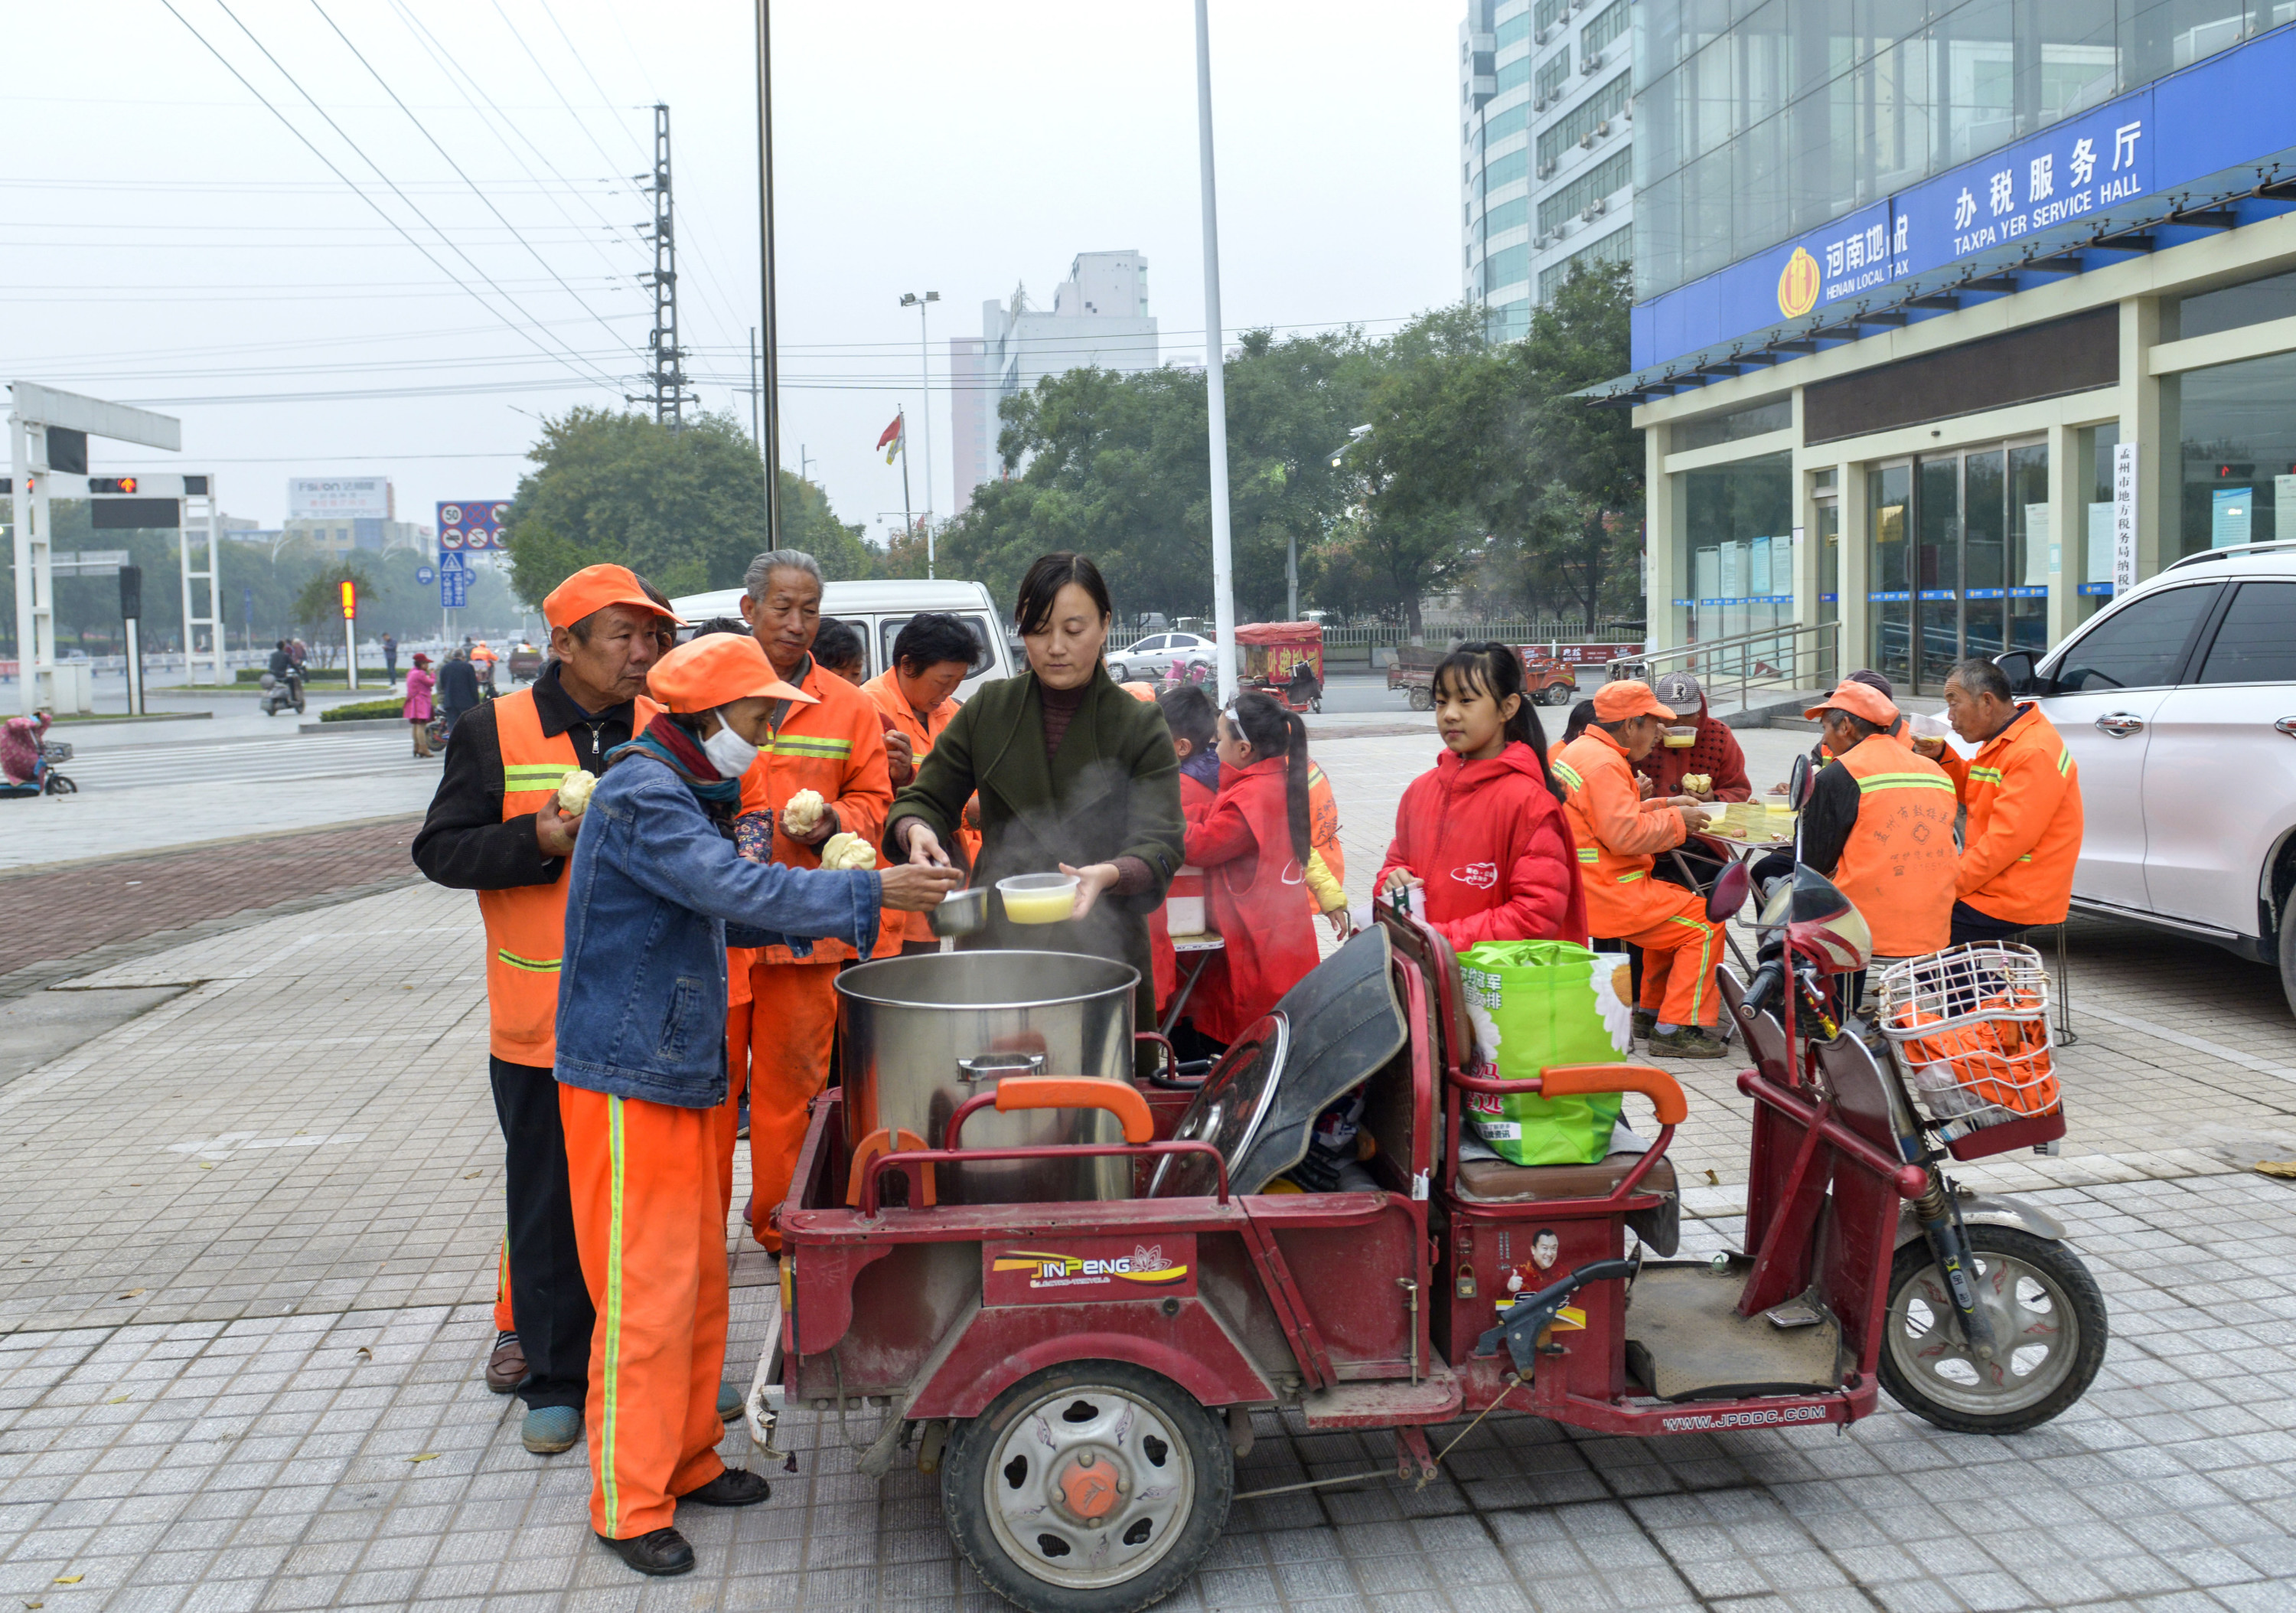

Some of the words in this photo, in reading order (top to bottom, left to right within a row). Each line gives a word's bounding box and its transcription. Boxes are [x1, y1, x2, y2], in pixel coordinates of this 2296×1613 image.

[1954, 120, 2142, 231] 办税服务厅
[1954, 225, 1996, 256] TAXPA
[2001, 214, 2027, 239] YER
[2033, 190, 2092, 228] SERVICE
[2100, 173, 2142, 204] HALL
[1826, 277, 1855, 300] HENAN
[1857, 267, 1885, 290] LOCAL
[445, 509, 458, 521] 50
[1662, 1405, 1826, 1431] WWW.JPDDC.COM
